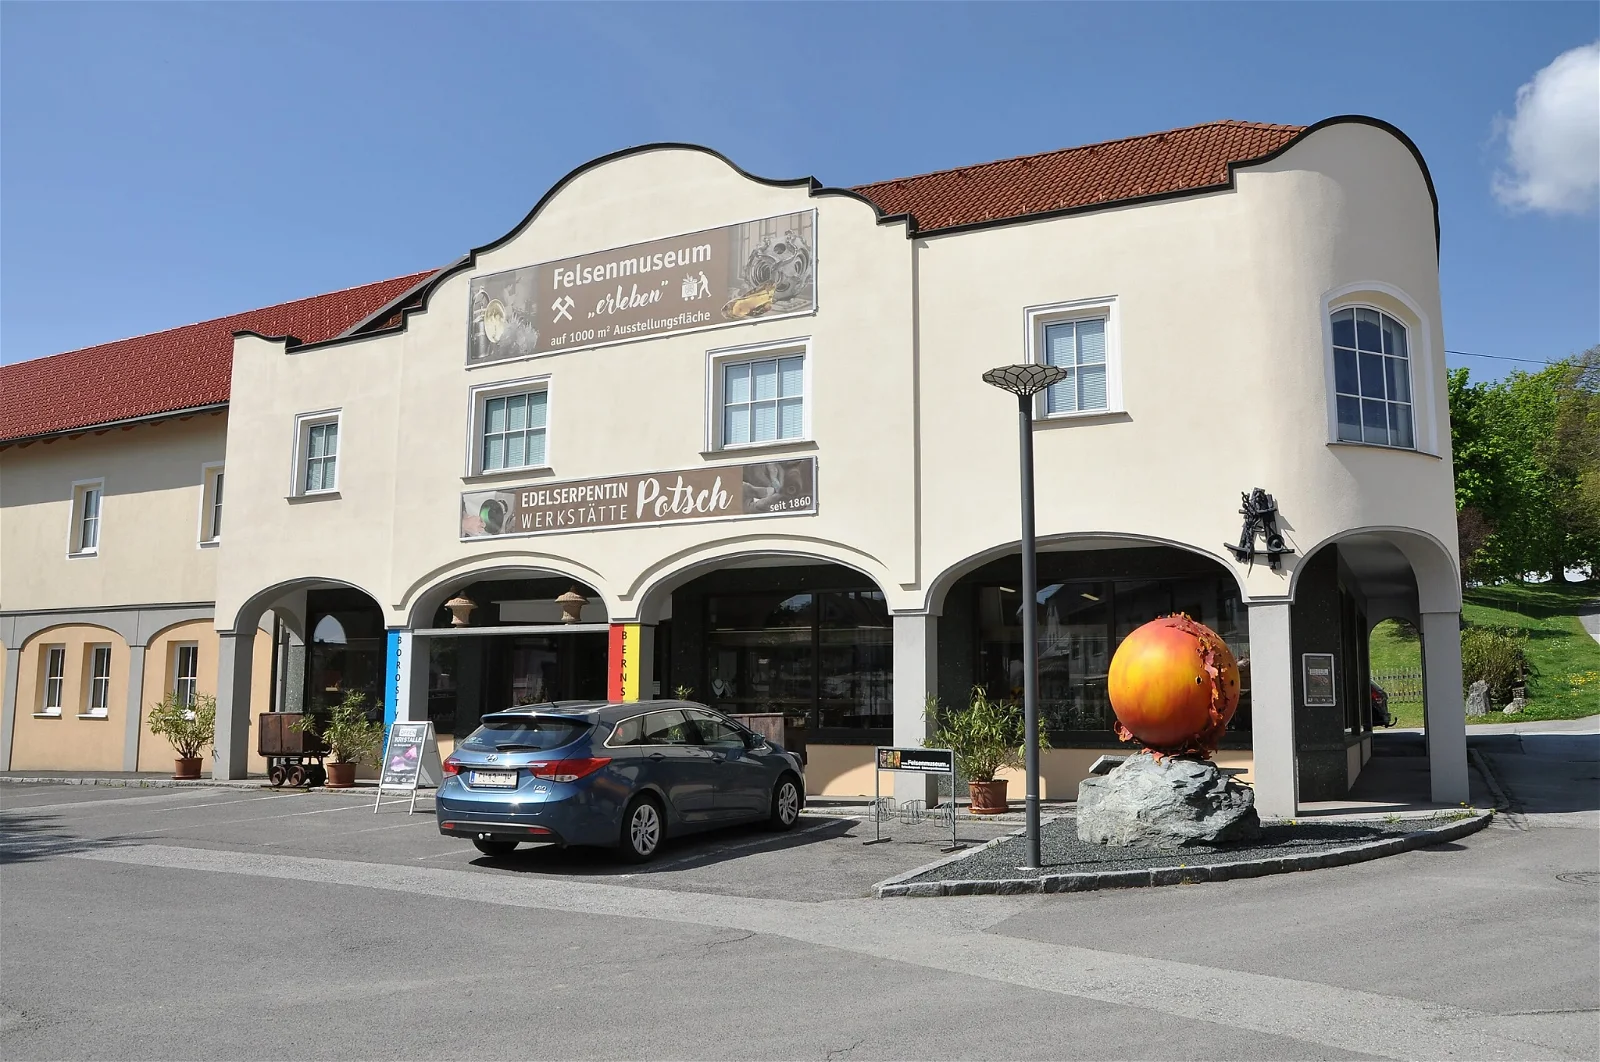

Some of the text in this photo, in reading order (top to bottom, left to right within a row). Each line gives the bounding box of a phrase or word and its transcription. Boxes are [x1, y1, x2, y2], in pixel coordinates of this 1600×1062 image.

[553, 243, 712, 290] Felsenmuseum
[550, 333, 567, 346] auf
[569, 329, 595, 343] 1000
[613, 311, 711, 336] Ausstellungsfläche
[521, 481, 628, 508] EDELSERPENTIN
[636, 475, 734, 519] Potsch
[769, 496, 811, 512] seit 1860
[521, 504, 628, 529] WERKSTÄTTE
